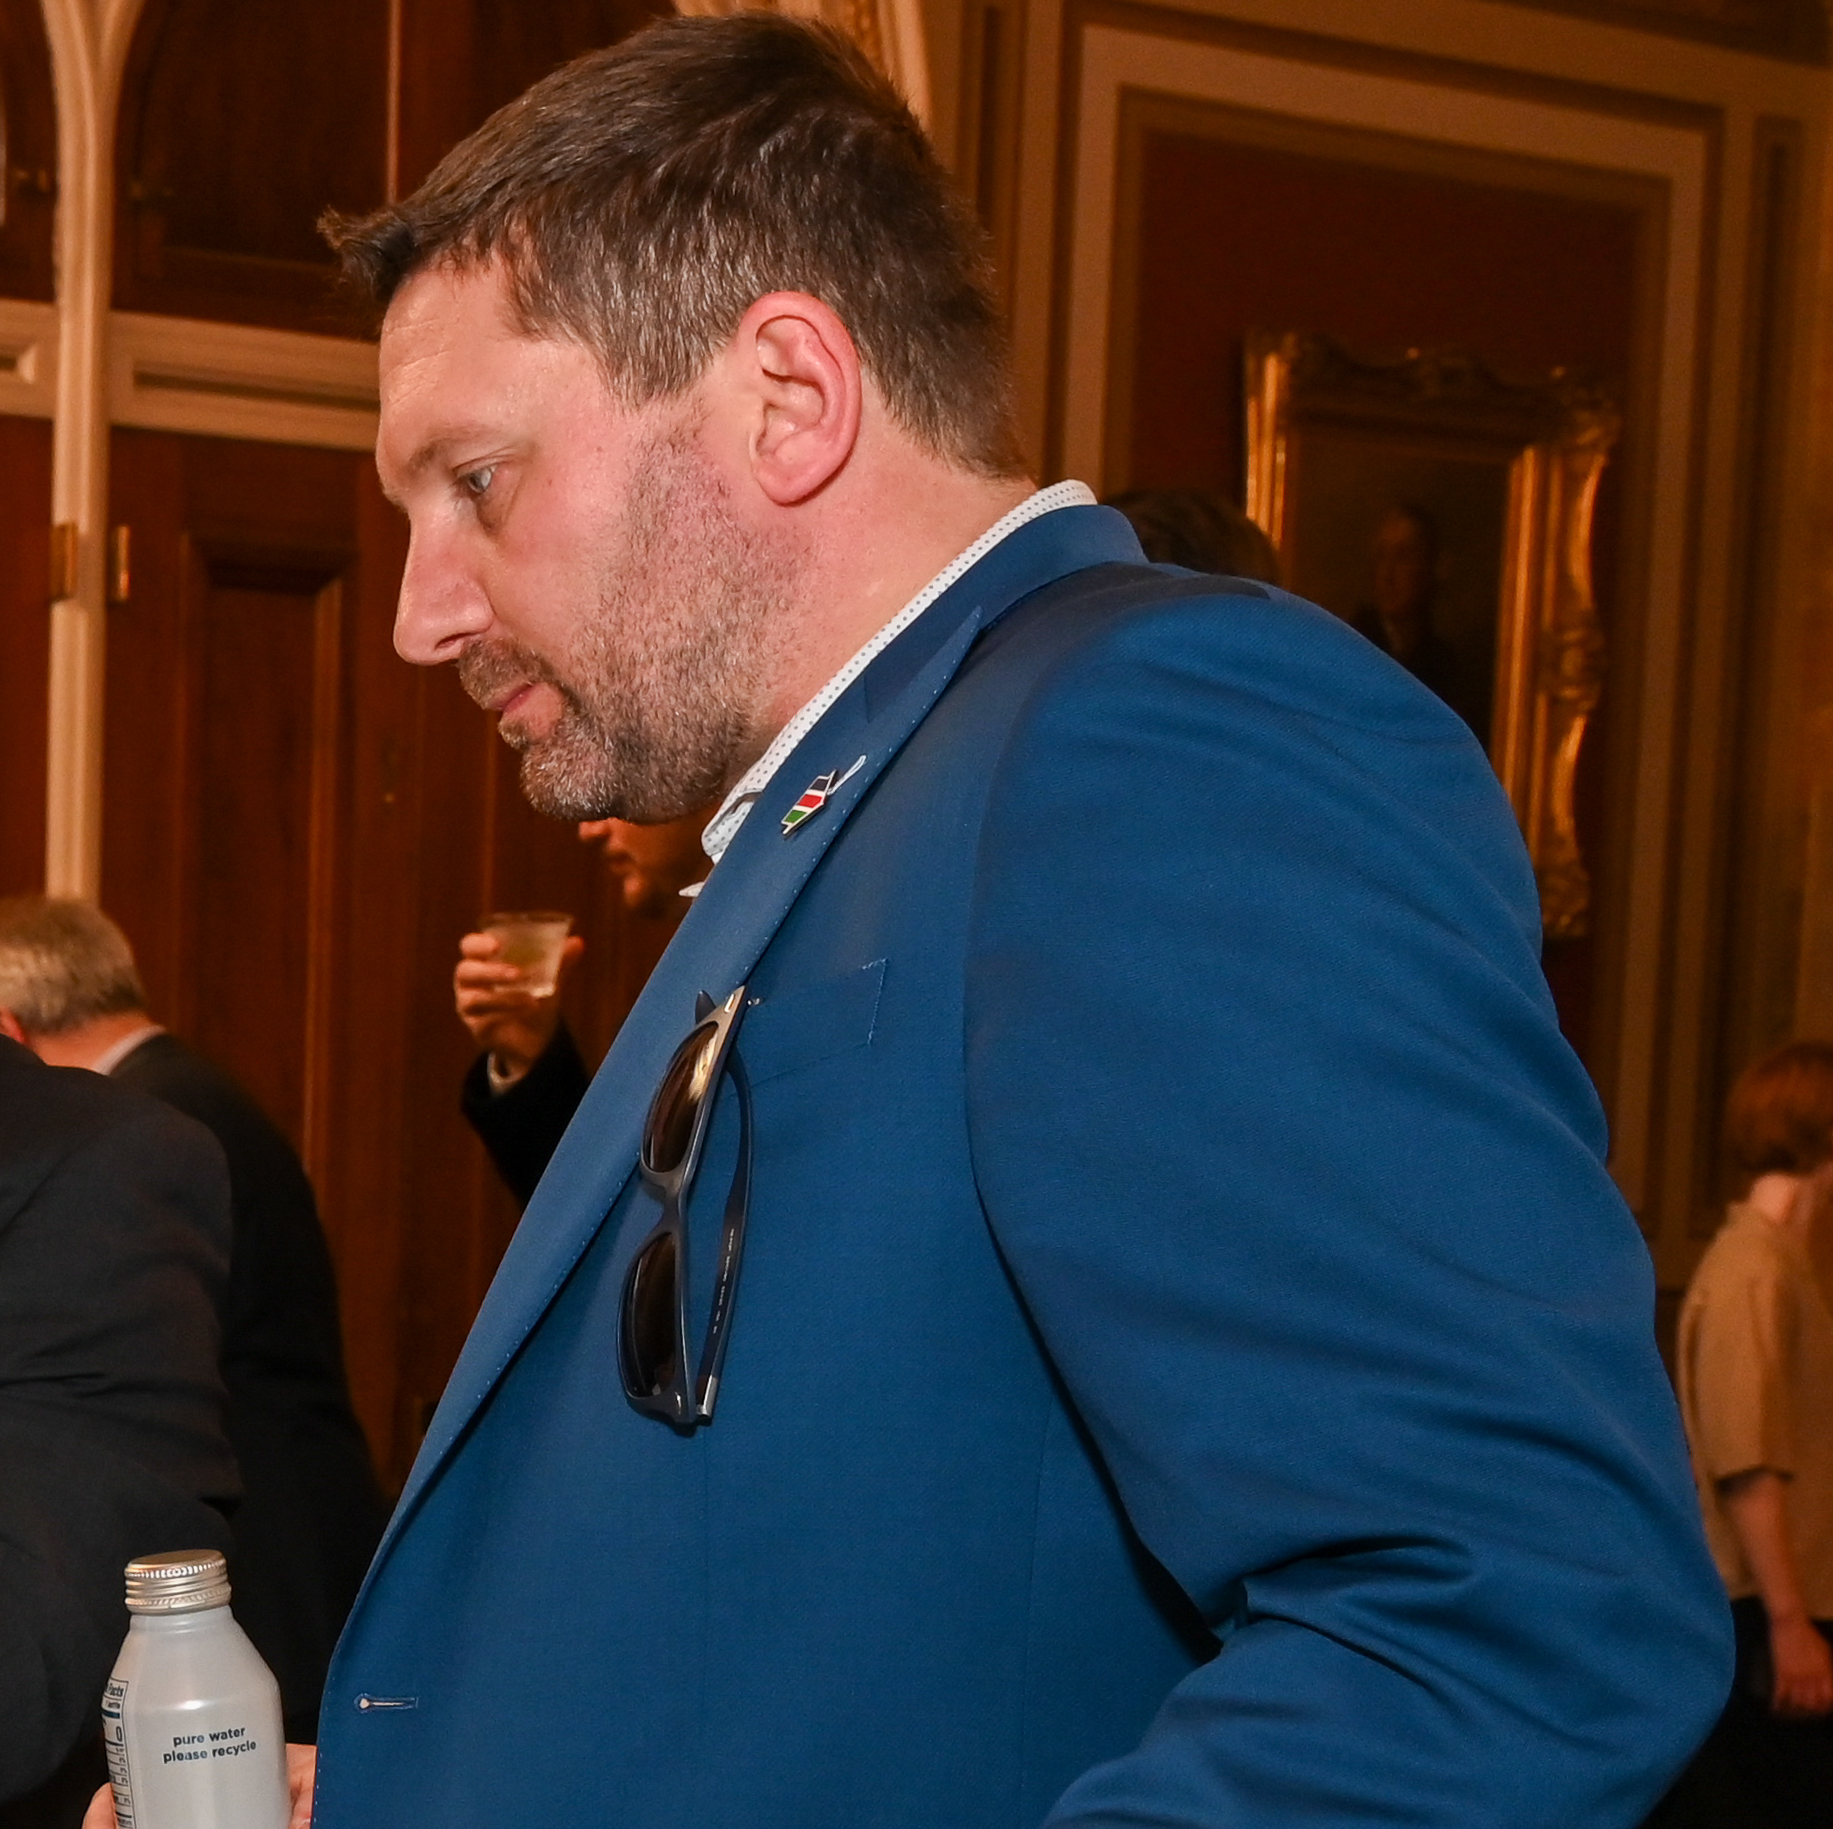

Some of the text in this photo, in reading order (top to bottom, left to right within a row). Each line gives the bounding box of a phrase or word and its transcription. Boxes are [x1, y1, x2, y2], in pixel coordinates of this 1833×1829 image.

[173, 1727, 246, 1747] pure water
[163, 1740, 256, 1764] please recycle
